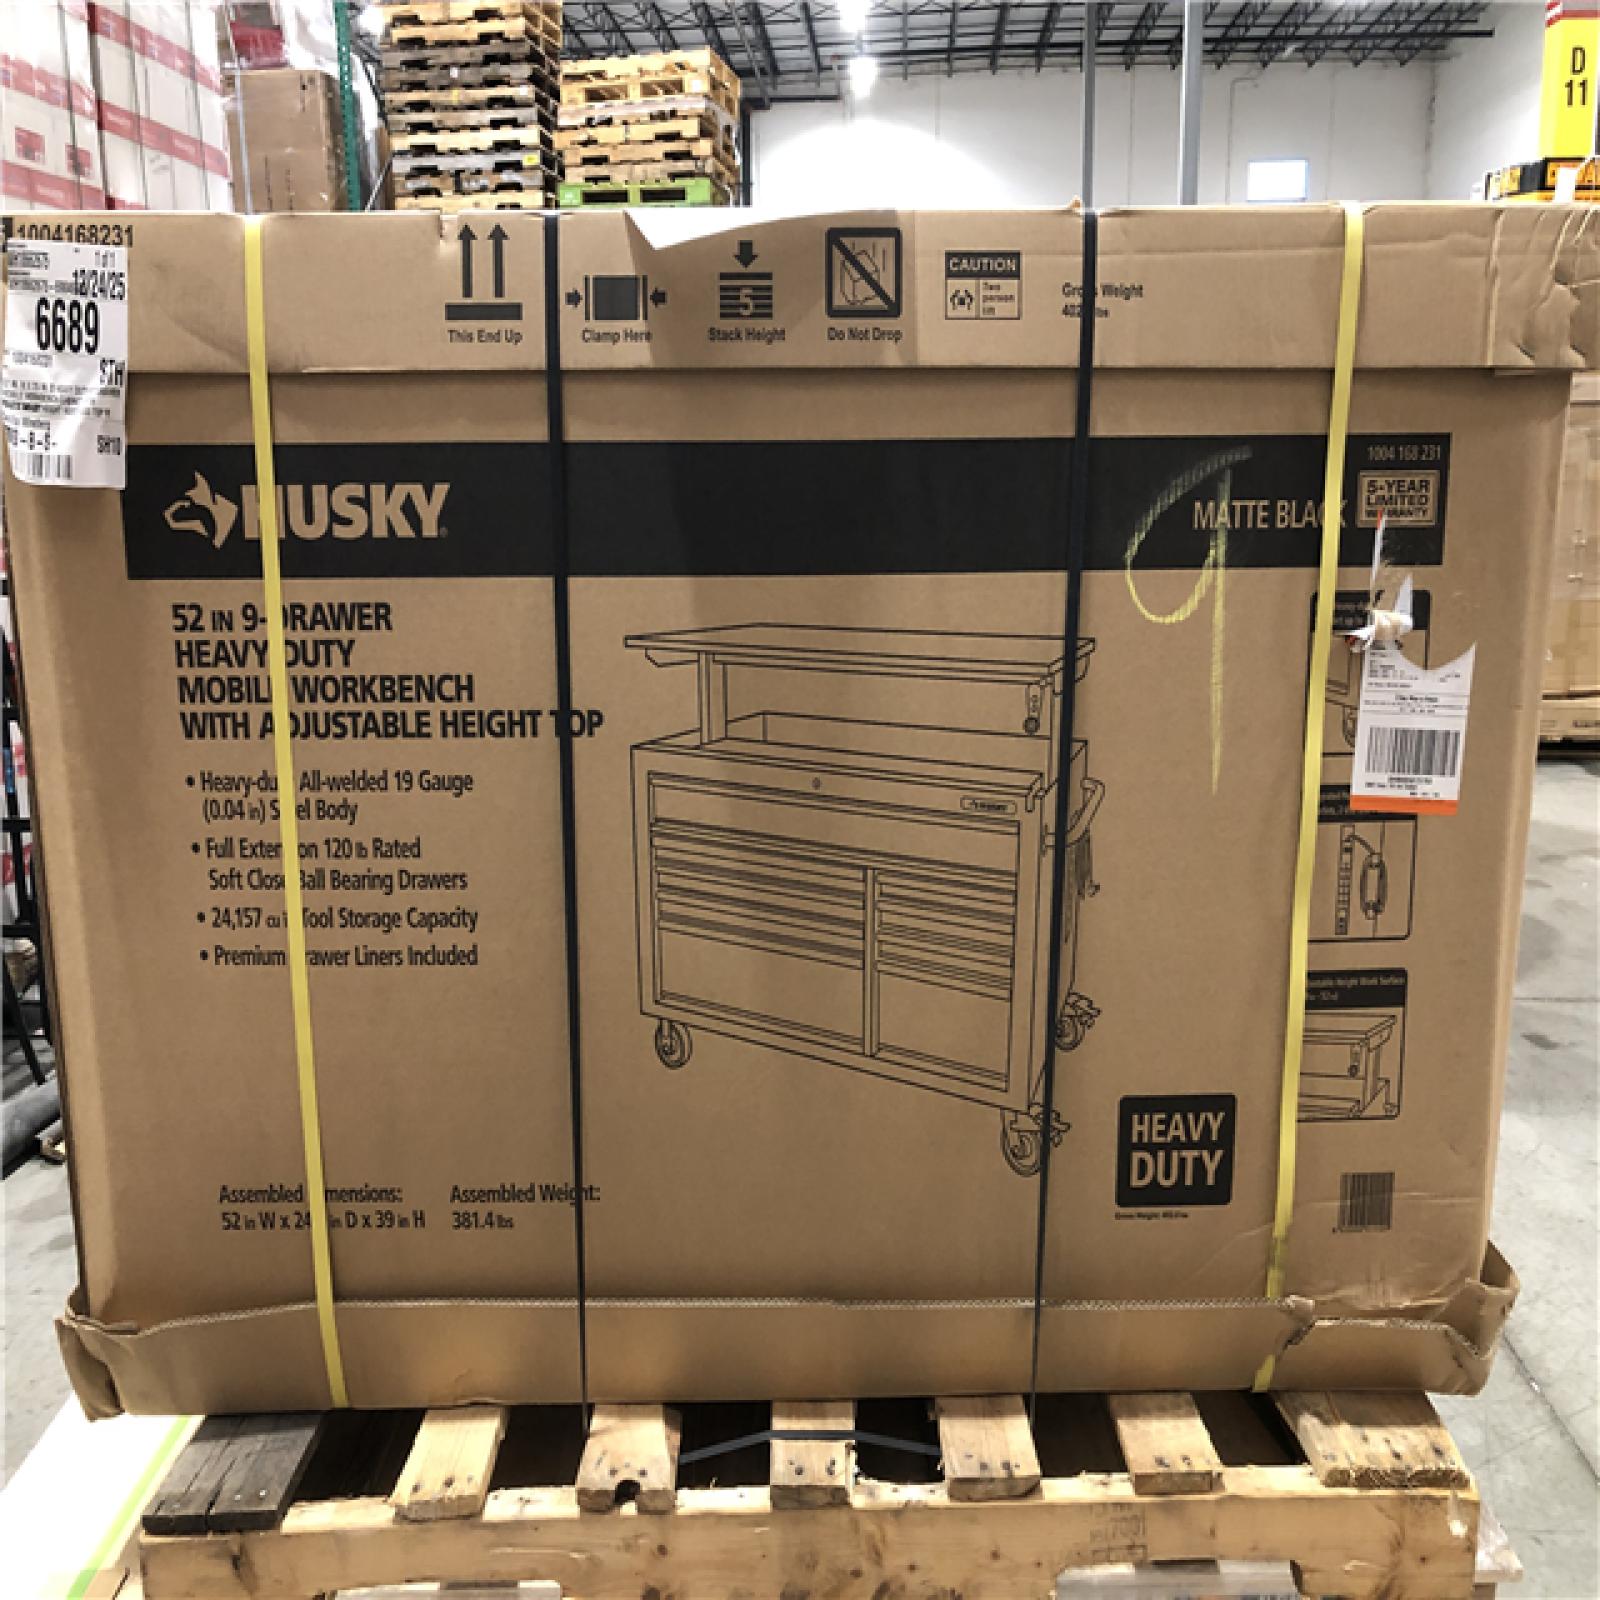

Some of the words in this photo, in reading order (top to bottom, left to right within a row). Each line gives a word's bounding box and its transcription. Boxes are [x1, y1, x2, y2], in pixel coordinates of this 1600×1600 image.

[1571, 46, 1587, 75] D
[1564, 79, 1588, 106] 11
[949, 257, 1017, 271] CAUTION
[739, 286, 755, 315] 5
[36, 297, 99, 355] 6689
[447, 328, 474, 343] This
[478, 328, 501, 343] End
[504, 328, 523, 346] Up
[581, 328, 621, 345] Clamp
[624, 329, 652, 343] Here
[708, 326, 743, 341] Stack
[745, 326, 786, 345] Height
[826, 326, 847, 341] Do
[848, 326, 871, 341] Not
[872, 326, 904, 344] Drop
[1367, 479, 1431, 494] 5-YEAR
[239, 482, 450, 540] HUSKY
[1191, 499, 1269, 530] MATTE
[171, 603, 206, 632] 52
[211, 609, 234, 632] IN
[241, 601, 393, 632] 9-RAWER
[174, 638, 269, 668] HEAVY
[177, 675, 274, 704] MOBIL
[290, 673, 475, 704] WORKBENCH
[179, 709, 251, 740] WITH
[439, 708, 543, 739] HEIGHT
[299, 767, 389, 792] All-welded
[394, 769, 414, 792] 19
[417, 769, 474, 797] Gauge
[270, 799, 312, 820] Sel
[316, 797, 358, 825] Body
[205, 837, 236, 859] Full
[323, 836, 353, 859] 120
[371, 834, 421, 859] Rated
[208, 866, 243, 890] Soft
[330, 866, 394, 896] Bearing
[397, 868, 469, 890] Drawers
[211, 906, 262, 931] 24,157
[338, 906, 401, 934] Storage
[407, 904, 479, 933] Capacity
[213, 944, 287, 967] Premium
[302, 950, 350, 967] rawer
[354, 944, 403, 967] Liners
[407, 944, 479, 967] Included
[1130, 1111, 1226, 1143] HEAVY
[1128, 1149, 1223, 1188] DUTY
[219, 1183, 304, 1203] Assembled
[451, 1182, 536, 1203] Assembled
[221, 1211, 241, 1231] 52
[258, 1211, 276, 1229] W
[279, 1215, 290, 1229] x
[344, 1211, 359, 1229] D
[361, 1214, 373, 1229] x
[374, 1209, 396, 1229] 39
[412, 1210, 426, 1228] H
[452, 1211, 494, 1231] 381.4
